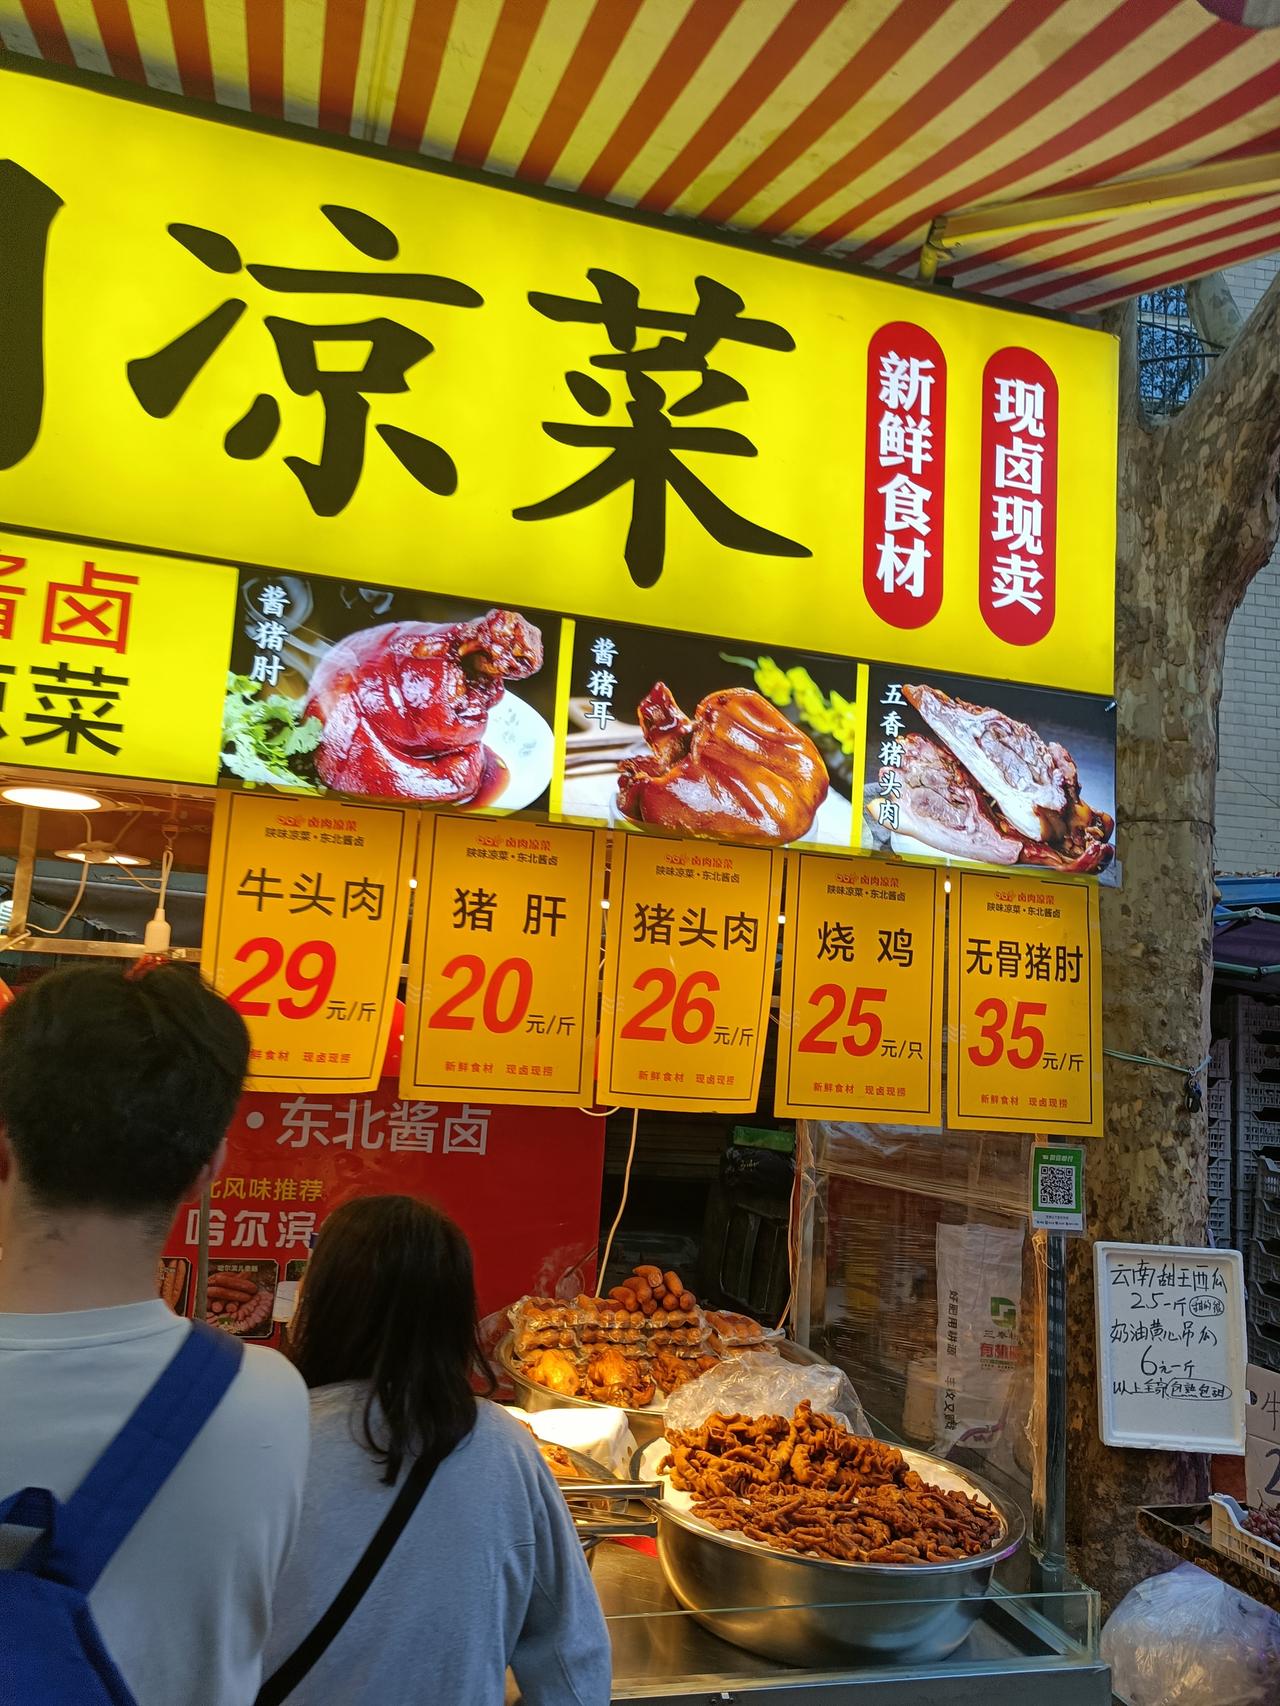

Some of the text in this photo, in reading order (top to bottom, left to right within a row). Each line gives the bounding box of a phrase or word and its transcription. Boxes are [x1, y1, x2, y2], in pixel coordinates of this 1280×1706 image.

[876, 351, 936, 597] 新鲜食材
[990, 376, 1046, 616] 现卤现卖
[250, 585, 290, 687] 酱猪肘
[0, 661, 130, 757] 菜
[584, 637, 620, 731] 酱猪耳
[879, 684, 908, 829] 五香猪头肉
[237, 867, 385, 921] 牛头肉
[633, 903, 759, 953] 猪头肉
[228, 937, 377, 1022] 29 元/斤
[428, 954, 577, 1037] 20 元/斤
[966, 937, 1084, 984] 无骨猪肘
[620, 968, 754, 1048] 26 元/斤
[798, 983, 924, 1061] 25 元/只
[967, 998, 1085, 1073] 35 元/斤
[639, 1070, 684, 1083] 新鲜食材
[813, 1082, 855, 1094] 新鲜食材
[981, 1094, 1019, 1106] 新鲜食材
